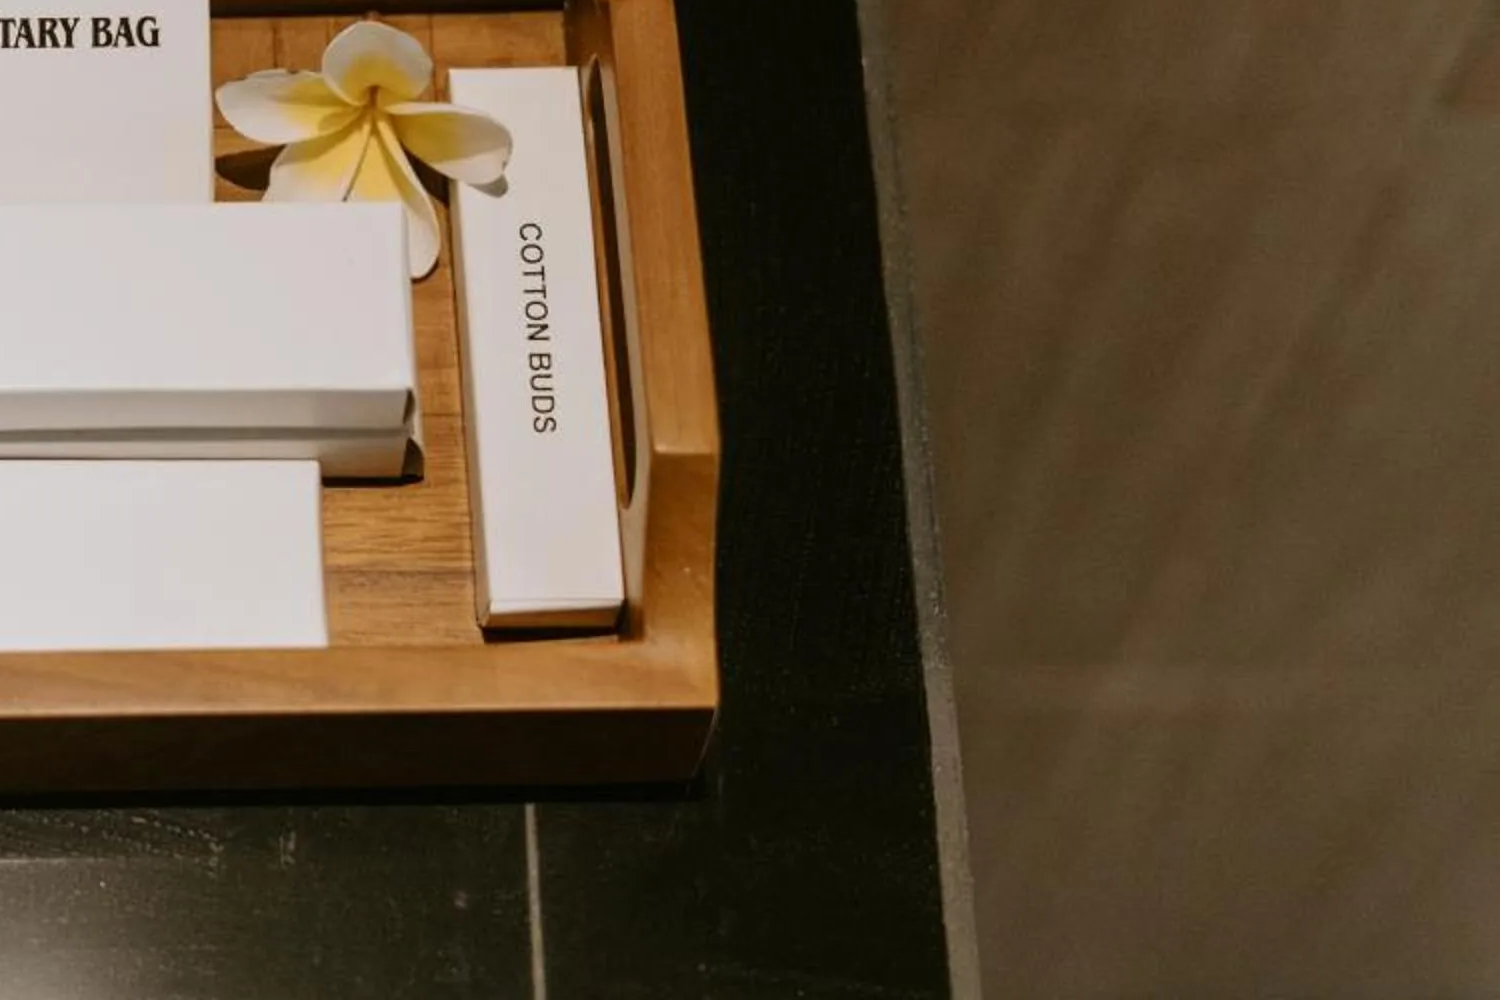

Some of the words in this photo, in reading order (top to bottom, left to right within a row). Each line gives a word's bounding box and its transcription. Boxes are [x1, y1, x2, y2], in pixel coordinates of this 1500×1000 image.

[90, 15, 161, 49] BAG
[518, 222, 551, 342] COTTON
[527, 351, 558, 434] BUDS
